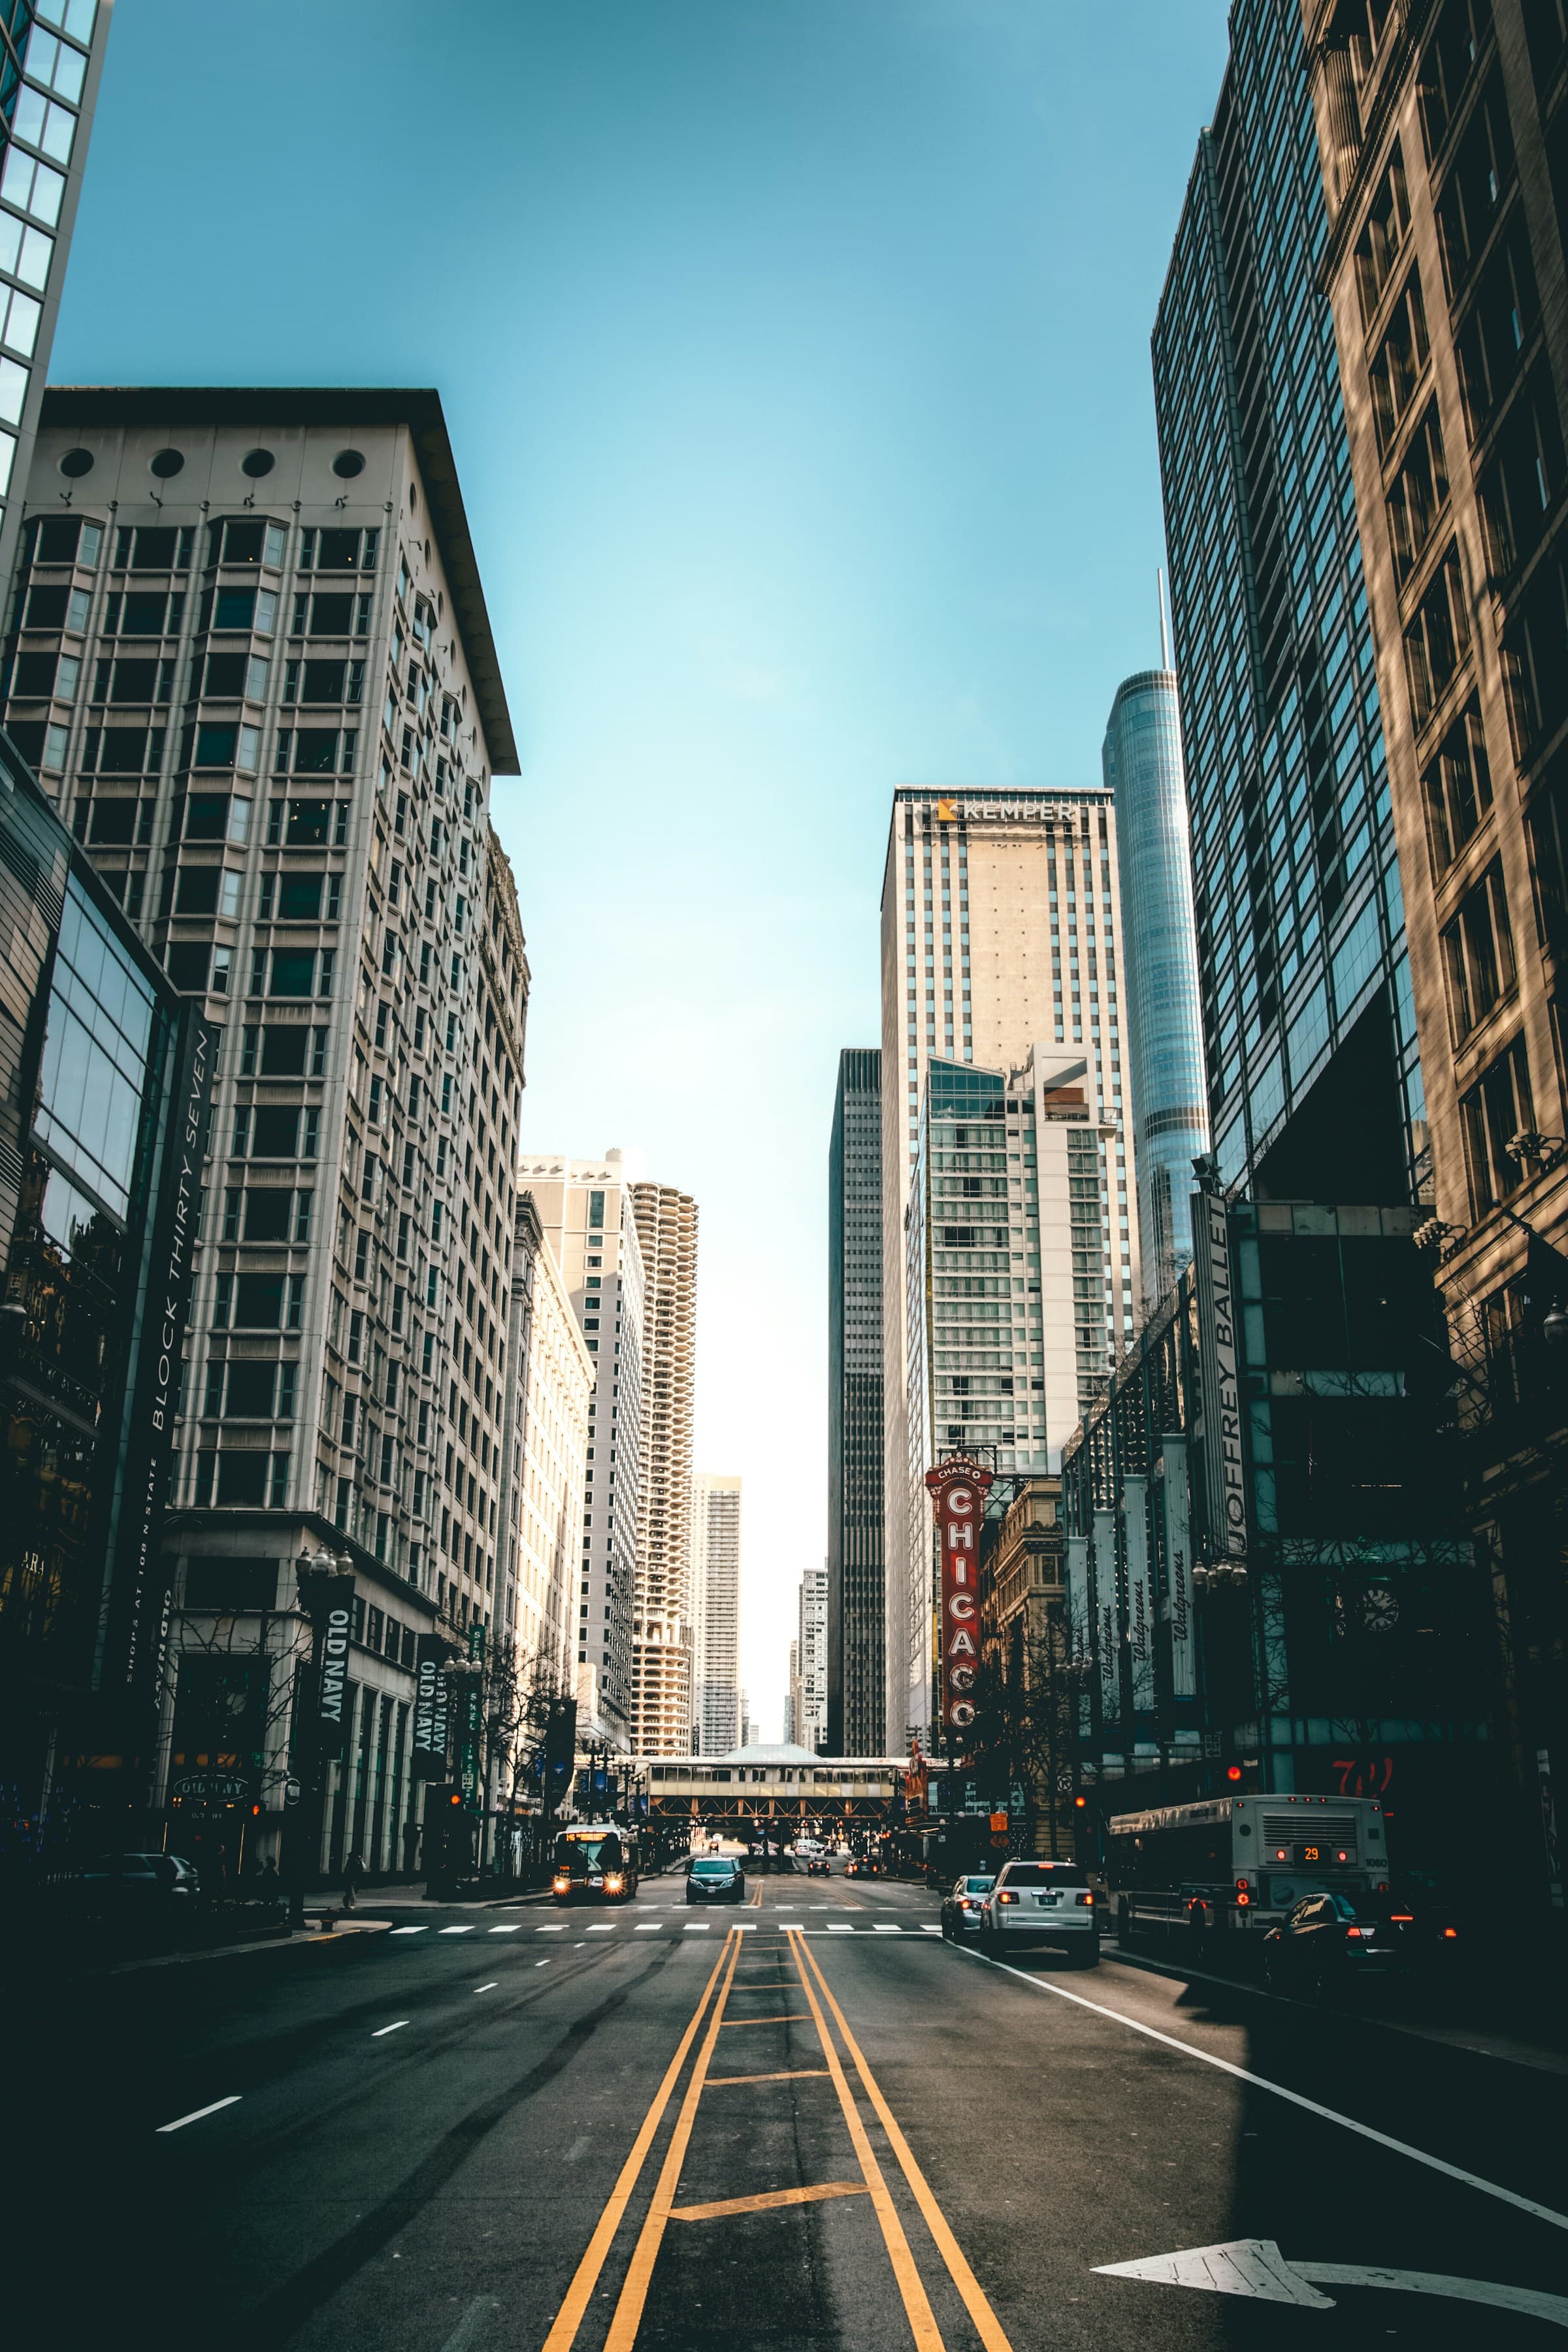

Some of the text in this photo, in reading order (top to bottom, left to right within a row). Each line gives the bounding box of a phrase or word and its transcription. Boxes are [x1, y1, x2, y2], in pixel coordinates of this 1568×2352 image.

[964, 802, 1072, 820] KEMPER
[152, 1030, 208, 1431] BLOCK THIRTY SEVEN
[1209, 1198, 1247, 1555] JOFFREY BALLET
[938, 1467, 972, 1478] CHASE
[127, 1458, 157, 1682] SHOPS AT 108 N STATE
[161, 1589, 172, 1638] OLD
[947, 1488, 976, 1727] CHICAGO
[1173, 1550, 1192, 1643] Walgreens
[1102, 1605, 1117, 1680] Walgreens
[1134, 1578, 1150, 1662] Walgreens
[321, 1610, 349, 1722] OLD NAVY
[416, 1661, 436, 1751] OLD NAVY
[1304, 1847, 1319, 1861] 29
